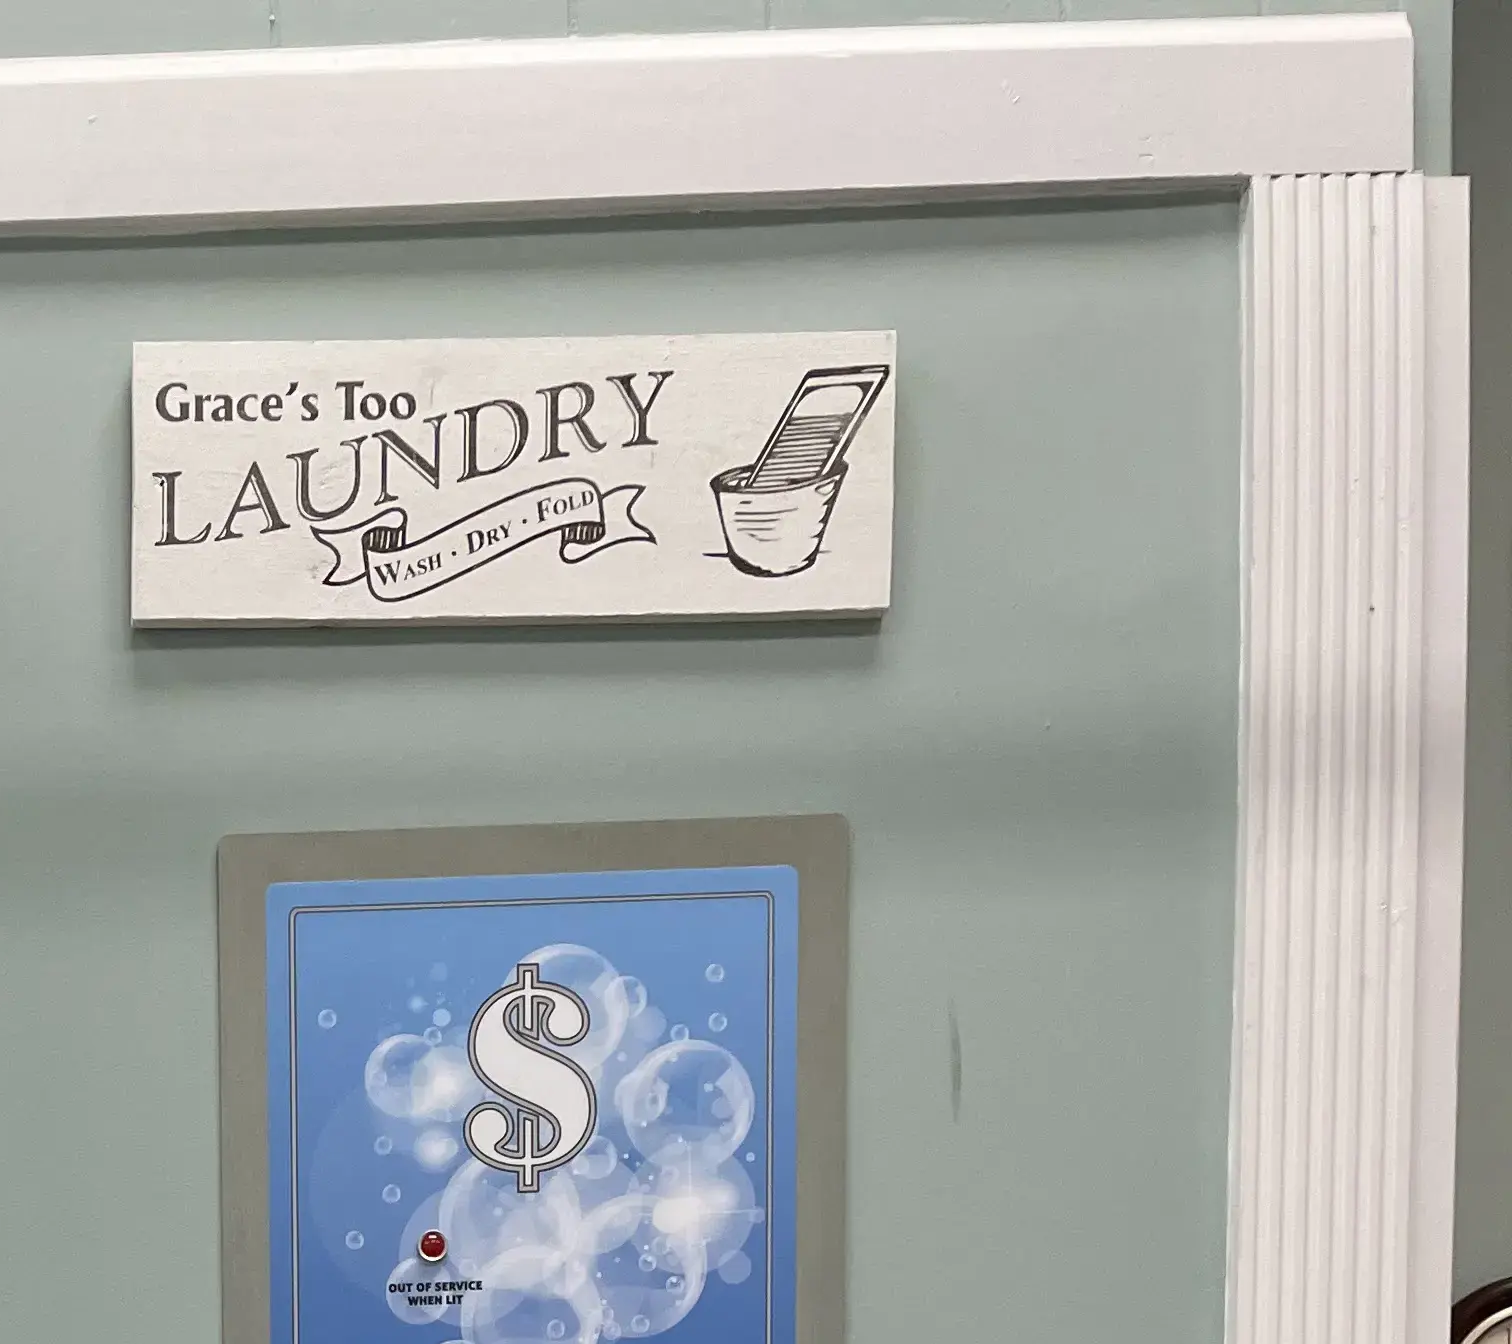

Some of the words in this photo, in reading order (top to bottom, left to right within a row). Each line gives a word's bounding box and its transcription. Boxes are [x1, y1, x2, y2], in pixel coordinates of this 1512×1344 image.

[156, 381, 319, 423] Grace's
[335, 380, 417, 421] Too
[153, 369, 675, 547] LAUNDRY
[462, 962, 598, 1194] $
[388, 1283, 413, 1293] OUT
[416, 1282, 432, 1292] OF
[434, 1280, 483, 1292] SERVICE
[407, 1295, 443, 1306] WHEN
[445, 1294, 464, 1305] LIT
